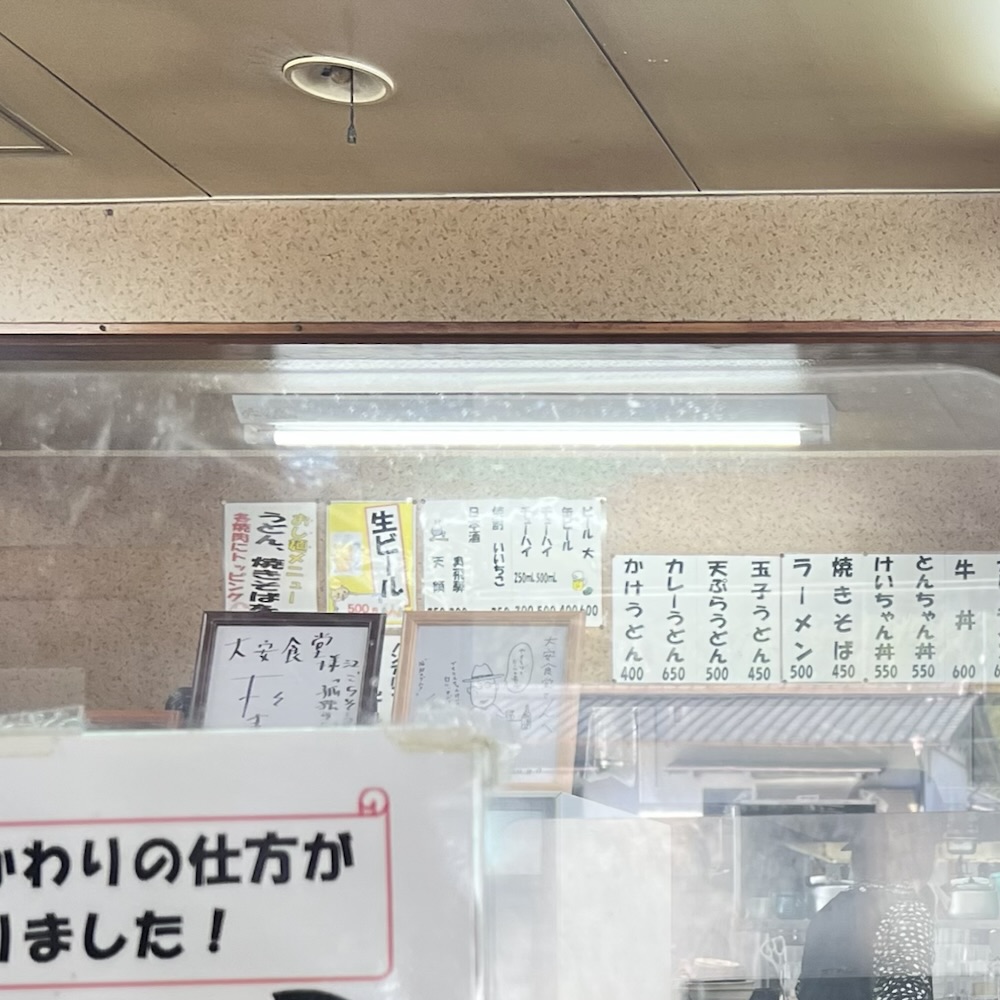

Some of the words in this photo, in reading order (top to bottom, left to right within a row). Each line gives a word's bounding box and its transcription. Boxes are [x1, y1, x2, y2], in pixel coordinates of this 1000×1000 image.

[371, 510, 404, 599] 生ビール
[493, 543, 505, 588] いいちこ
[624, 558, 644, 663] かけうどん
[665, 558, 685, 663] カレーうどん
[707, 560, 728, 664] 天ぷらうどん
[751, 561, 771, 663] 玉子うどん
[793, 558, 813, 661] ラーメン
[832, 557, 853, 660] 焼きそば
[874, 557, 895, 660] けいちゃん丼
[915, 556, 936, 660] とんちゃん丼
[955, 559, 976, 631] 牛丼
[224, 632, 333, 663] 大安食堂
[620, 666, 644, 681] 400
[662, 666, 686, 681] 650
[705, 666, 729, 681] 500
[748, 666, 771, 681] 450
[790, 664, 813, 679] 500
[831, 664, 855, 679] 450
[874, 664, 898, 679] 550
[912, 664, 935, 678] 550
[952, 664, 976, 678] 600
